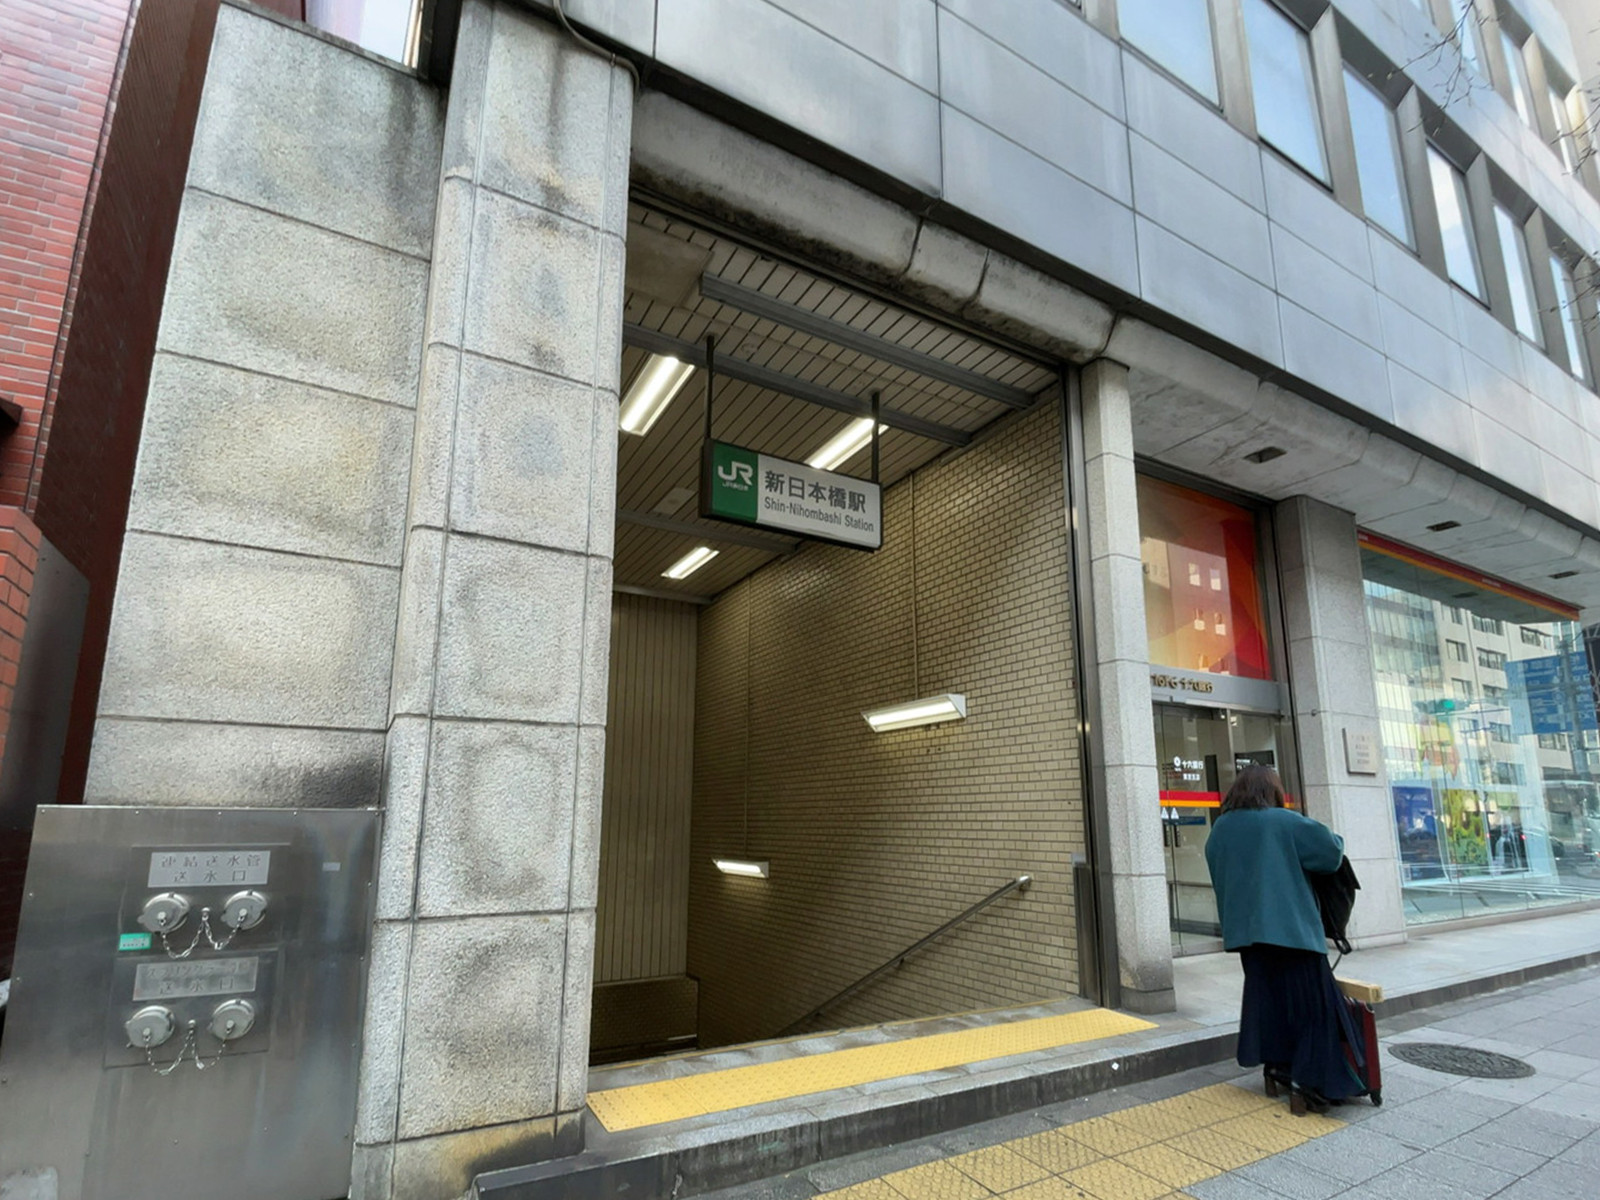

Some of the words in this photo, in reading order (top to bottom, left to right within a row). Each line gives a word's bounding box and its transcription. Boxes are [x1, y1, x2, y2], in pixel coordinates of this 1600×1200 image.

[717, 461, 753, 485] JR
[764, 470, 866, 513] 新日本橋駅
[764, 497, 842, 525] Shin-Nihombashi
[844, 515, 874, 532] Station
[173, 870, 247, 883] 送水口
